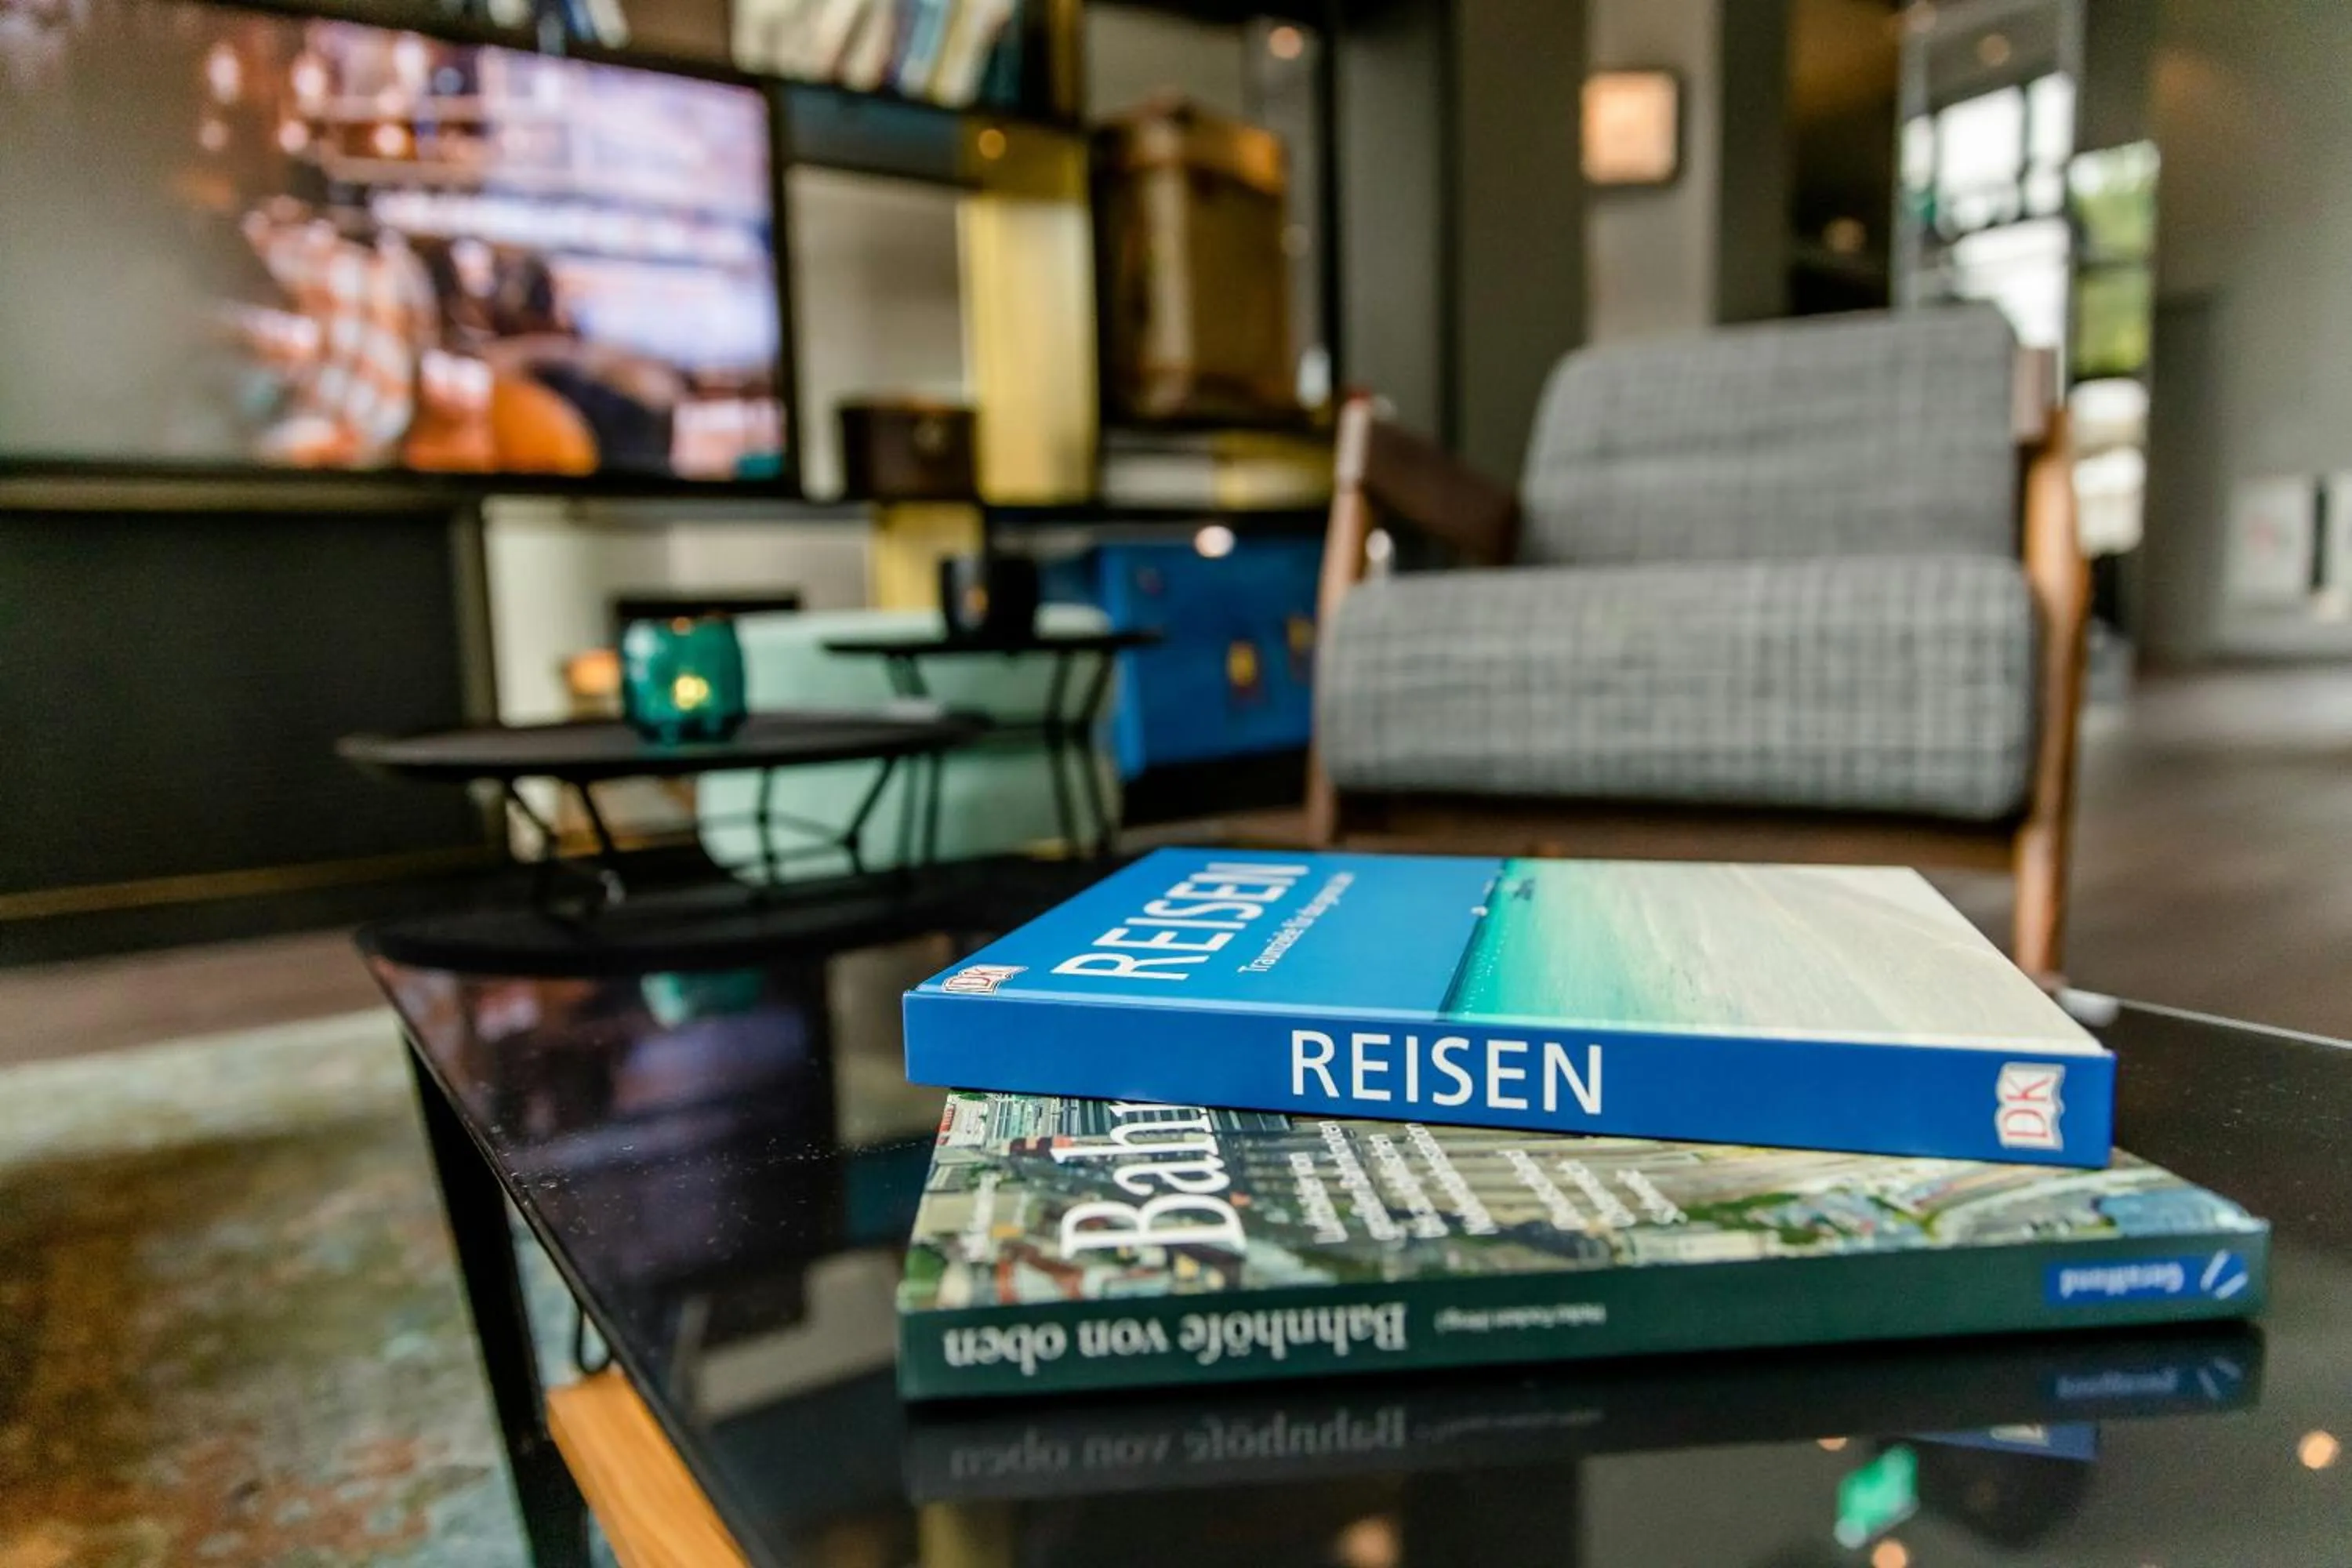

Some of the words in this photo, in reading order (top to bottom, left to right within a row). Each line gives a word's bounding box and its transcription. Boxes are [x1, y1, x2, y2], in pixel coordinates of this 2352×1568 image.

[1050, 862, 1309, 981] REISEN
[946, 966, 1011, 989] DK
[1291, 1029, 1603, 1114] REISEN
[2001, 1073, 2058, 1141] DK
[943, 1323, 1067, 1377] oben
[1079, 1317, 1169, 1358] von
[1178, 1301, 1406, 1366] Bahnhöfe
